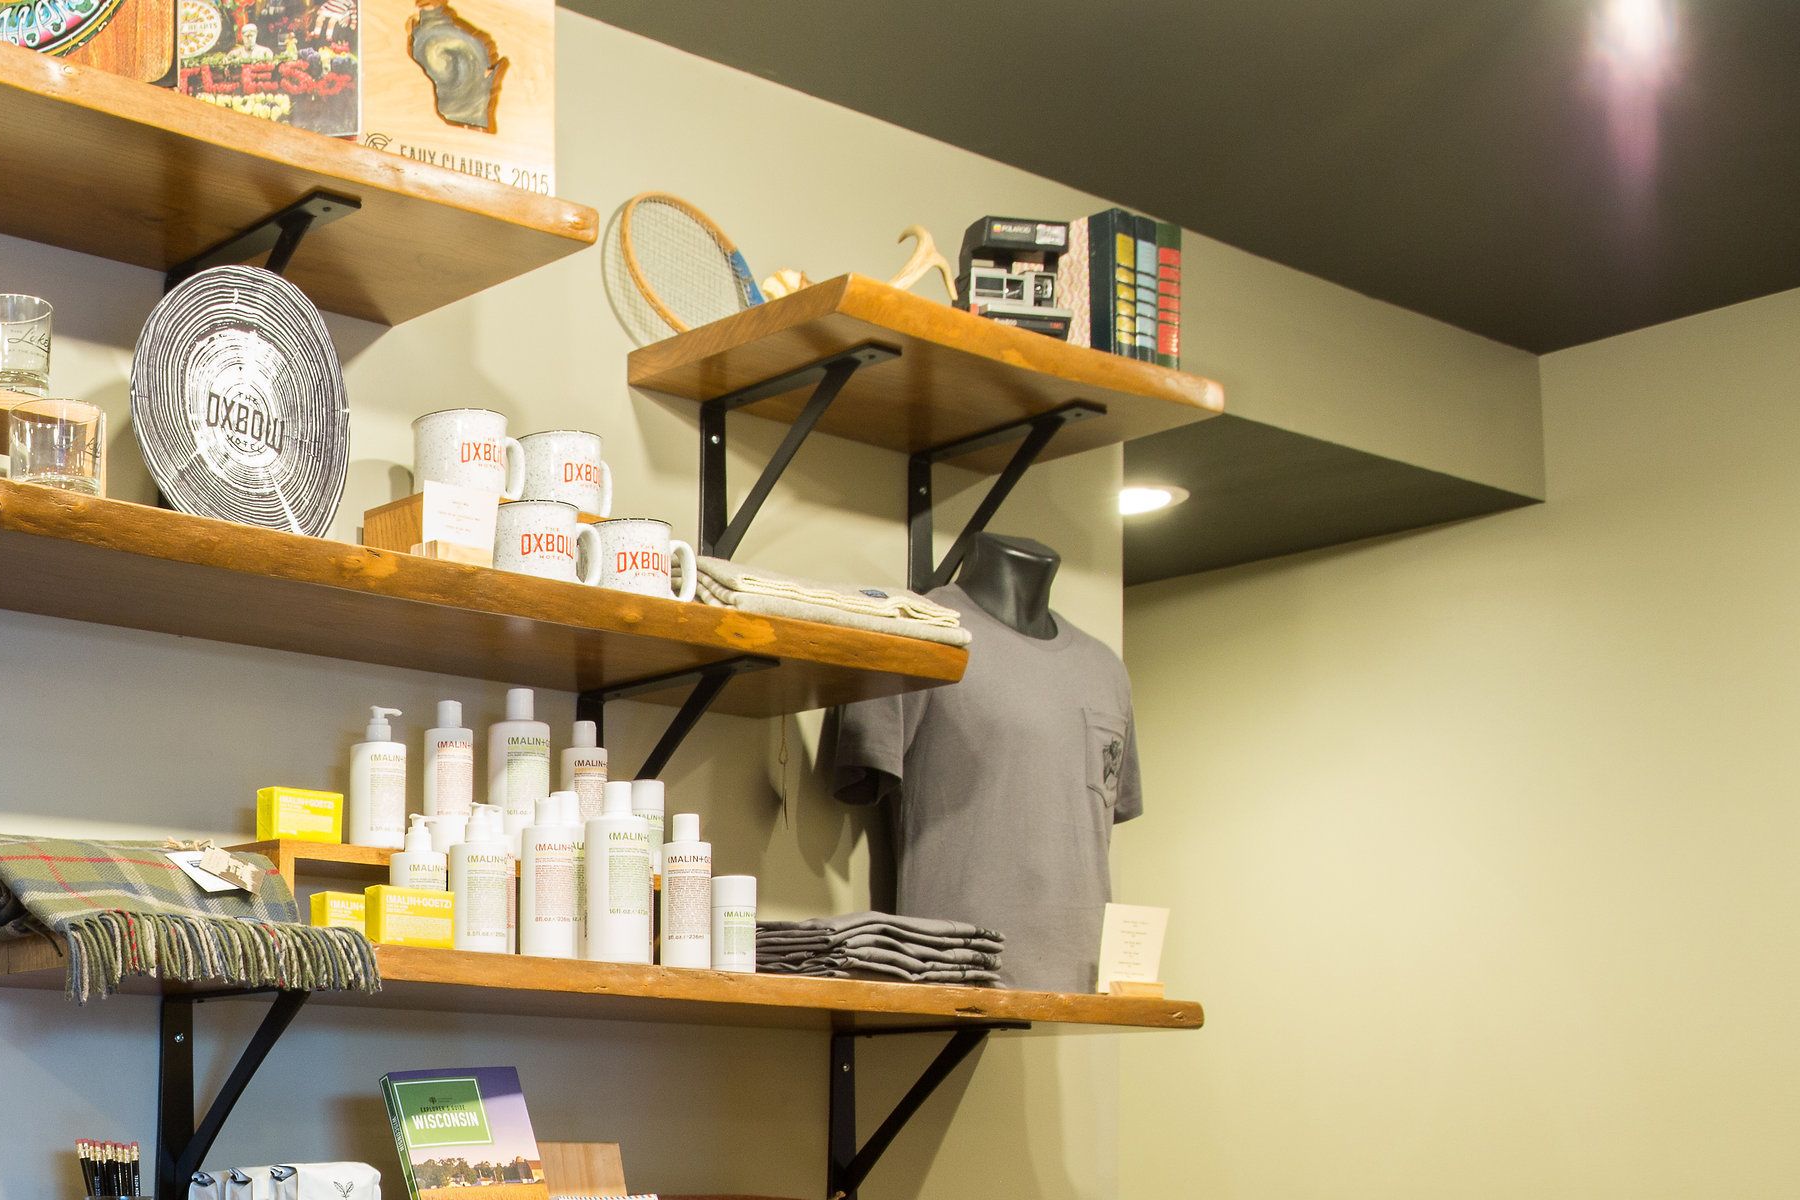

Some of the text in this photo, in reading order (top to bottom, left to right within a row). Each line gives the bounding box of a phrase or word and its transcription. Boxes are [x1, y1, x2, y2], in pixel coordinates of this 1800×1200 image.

[511, 168, 549, 195] 2015
[205, 390, 285, 456] OXBOW
[411, 1111, 480, 1130] WISCONSIN
